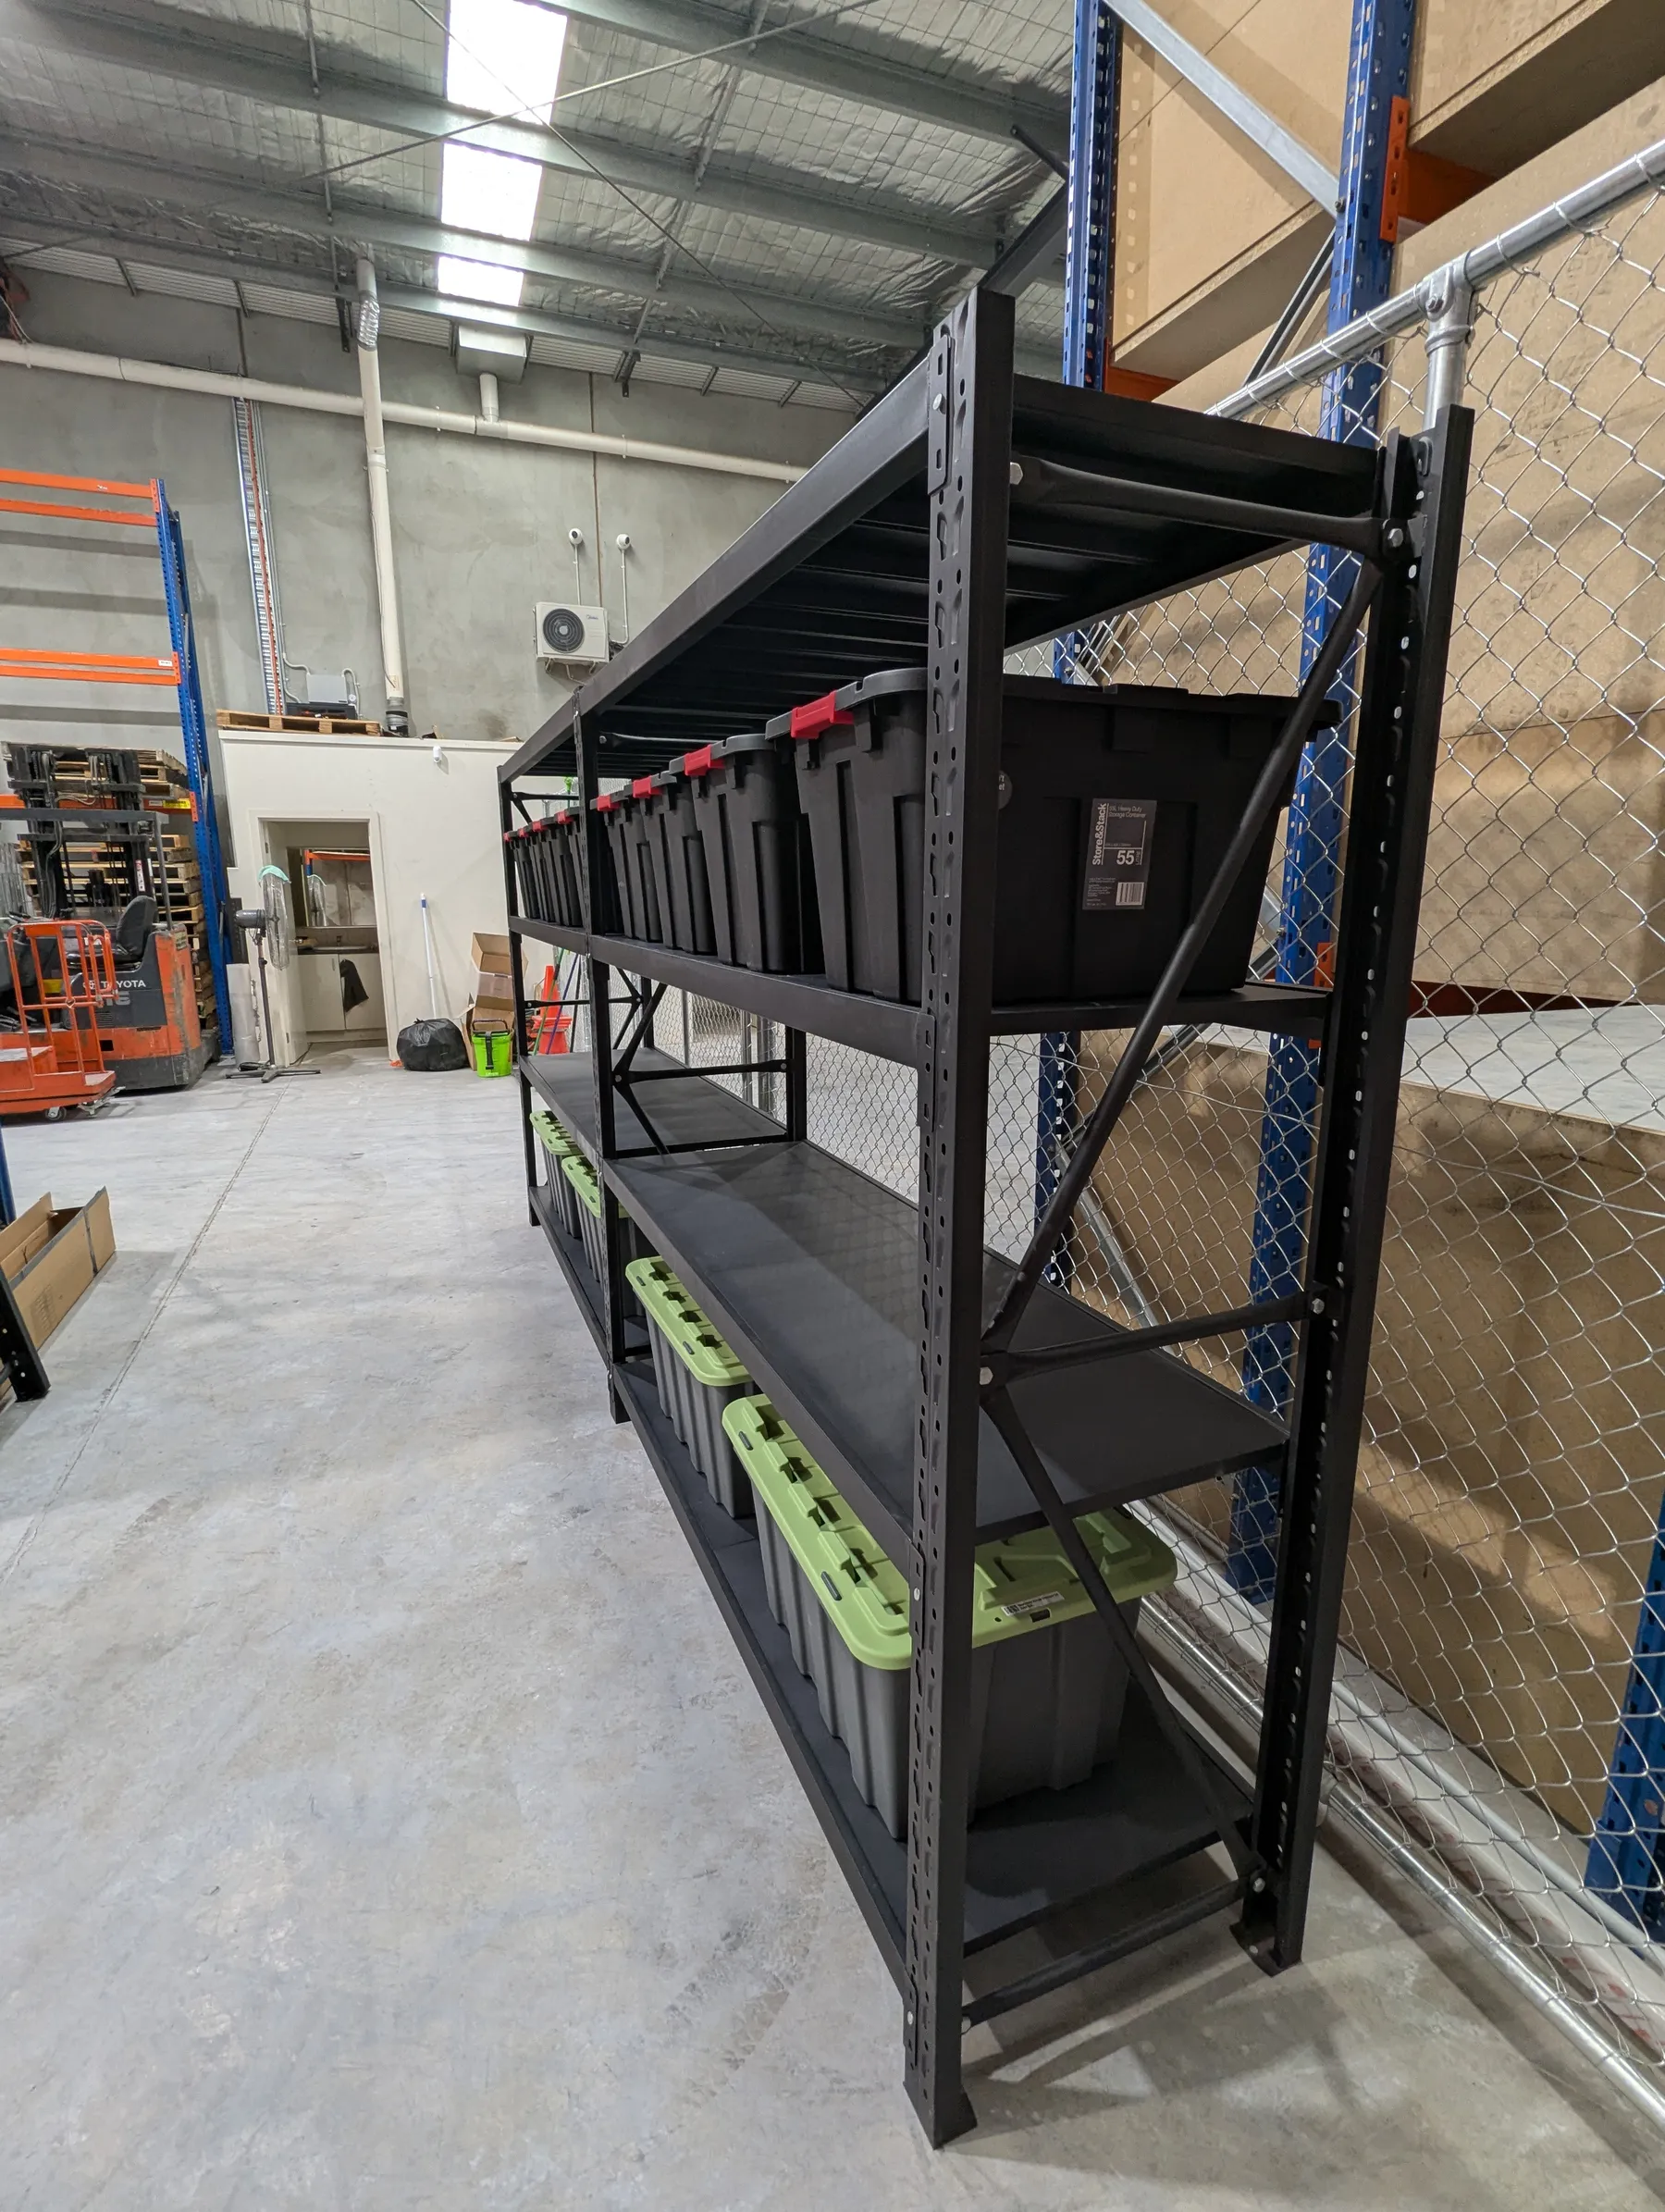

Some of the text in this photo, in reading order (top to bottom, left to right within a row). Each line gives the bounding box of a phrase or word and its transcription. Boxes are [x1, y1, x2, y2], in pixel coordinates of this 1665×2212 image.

[1092, 803, 1106, 865] Store&Stack
[1116, 850, 1134, 865] 55
[101, 980, 146, 988] TYOTA
